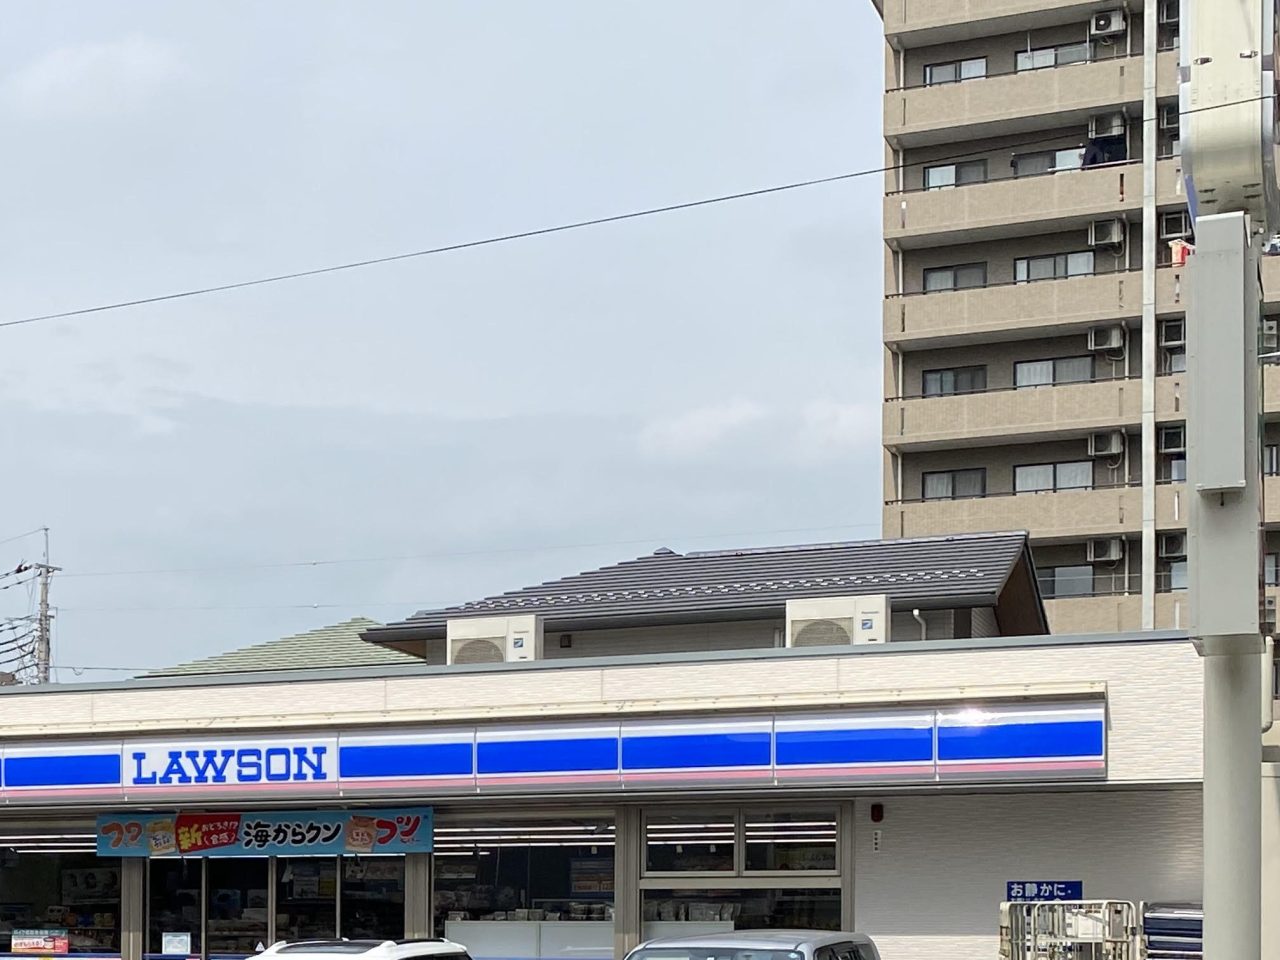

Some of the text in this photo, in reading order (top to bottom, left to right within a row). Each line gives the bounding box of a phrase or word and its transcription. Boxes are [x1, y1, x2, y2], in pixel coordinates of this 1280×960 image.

[132, 746, 328, 785] LAWSON
[178, 824, 203, 850] 新
[242, 820, 342, 849] 海からクン
